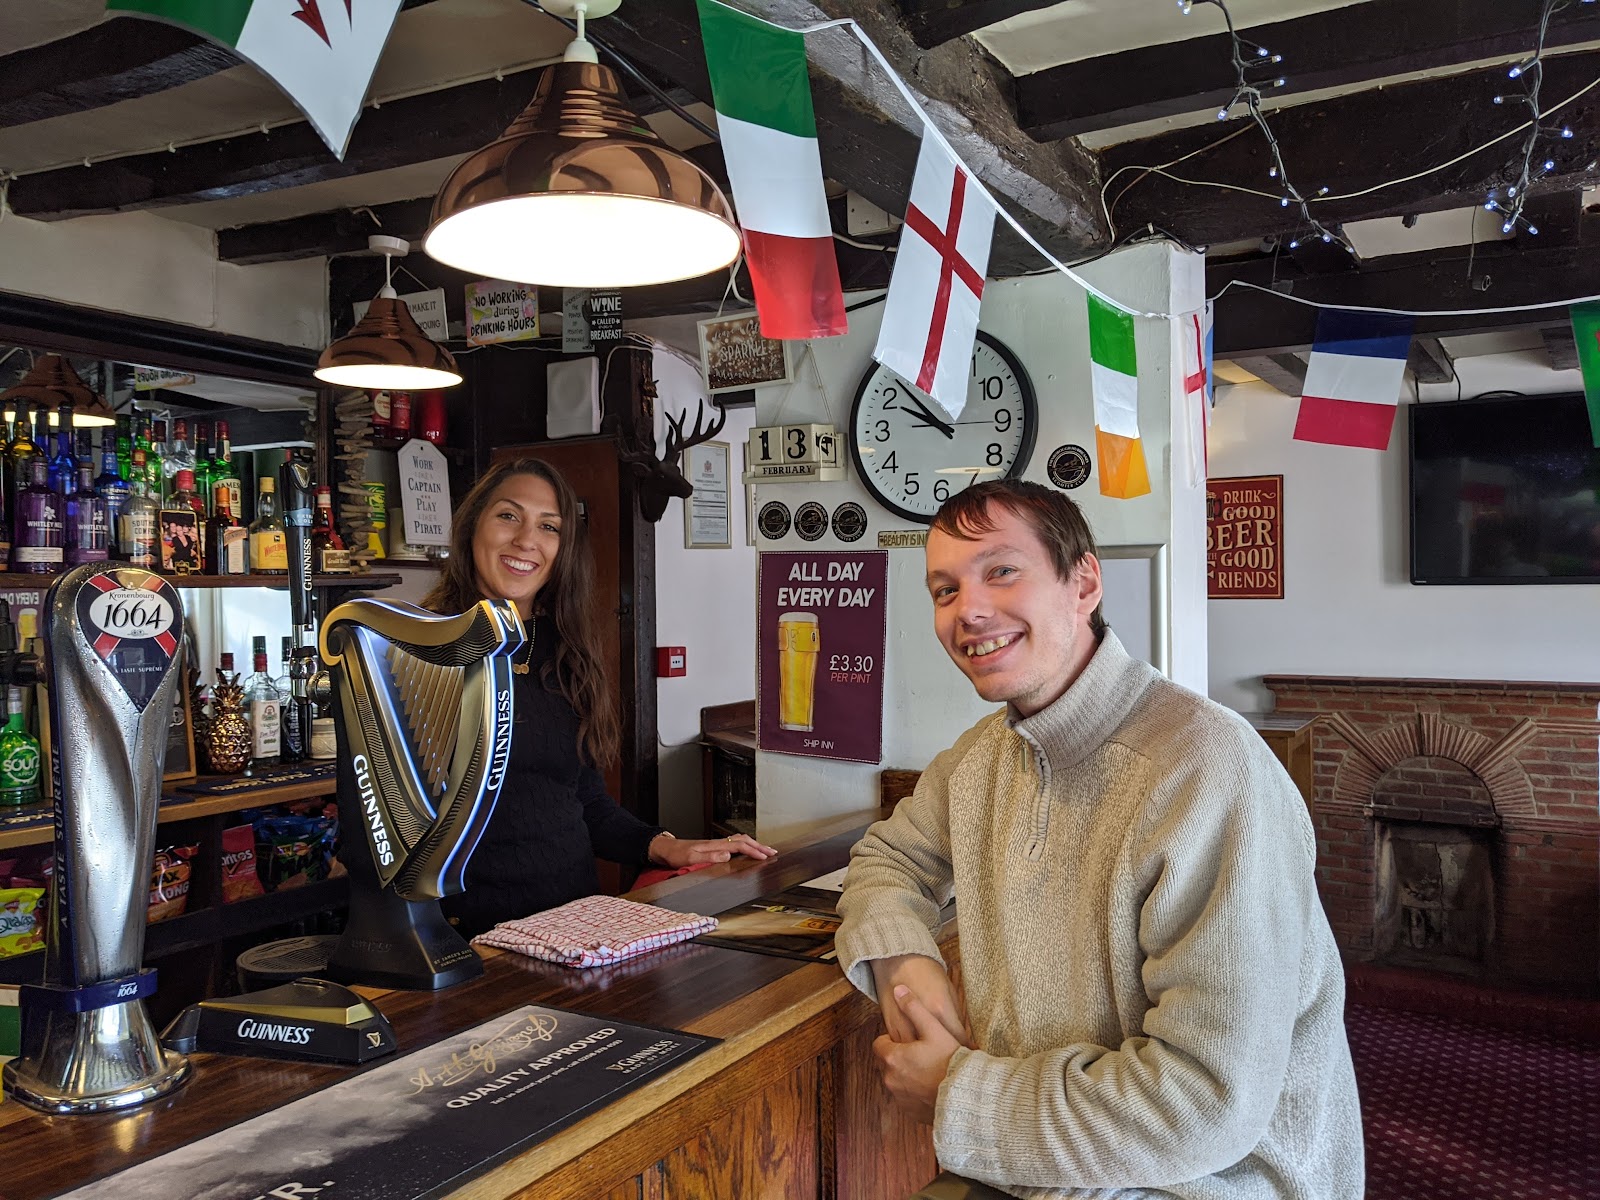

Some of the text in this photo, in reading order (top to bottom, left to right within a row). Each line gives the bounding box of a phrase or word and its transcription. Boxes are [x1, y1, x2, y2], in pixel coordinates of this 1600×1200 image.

[412, 301, 437, 313] MAKE IT
[475, 296, 486, 307] NO
[494, 306, 519, 319] during
[471, 317, 536, 337] DRINKING HOURS
[591, 329, 622, 340] BREAKFAST
[720, 339, 768, 362] SPARKLE
[978, 376, 1003, 400] 10
[882, 387, 898, 410] 2
[994, 408, 1011, 432] 9
[875, 420, 890, 442] 3
[759, 428, 807, 460] 1 3
[412, 455, 433, 470] WORK
[881, 450, 899, 474] 4
[986, 443, 1003, 466] 8
[763, 465, 812, 475] FEBRUARY
[964, 469, 980, 486] 7
[408, 477, 441, 493] CAPTAIN
[904, 473, 920, 495] 5
[933, 479, 950, 502] 6
[416, 498, 437, 512] PLAY
[1223, 490, 1261, 504] DRINK
[1222, 505, 1276, 521] GOOD
[27, 520, 53, 528] WHITLEY
[414, 520, 443, 535] PIRATE
[883, 534, 909, 547] BEAUTY
[303, 538, 313, 591] GUINNESS
[1220, 546, 1274, 570] GOOD
[788, 562, 864, 581] ALL DAY
[109, 592, 155, 601] Kronenbourg
[777, 587, 875, 608] EVERY DAY
[104, 600, 166, 629] 1664
[829, 654, 873, 673] £3.30
[830, 673, 871, 684] PER PINT
[486, 689, 511, 791] GUINNESS
[803, 739, 834, 750] SHIP INN
[353, 753, 395, 867] GUINNESS
[57, 852, 67, 905] TASTE
[149, 881, 190, 903] TRONG
[61, 917, 67, 928] A
[117, 985, 138, 998] 1664
[237, 1018, 312, 1045] GUINNESS
[617, 1040, 673, 1066] GUINNESS
[622, 1061, 647, 1073] MADE
[658, 1043, 681, 1055] MORE
[446, 1027, 616, 1109] QUALITY APPROVED
